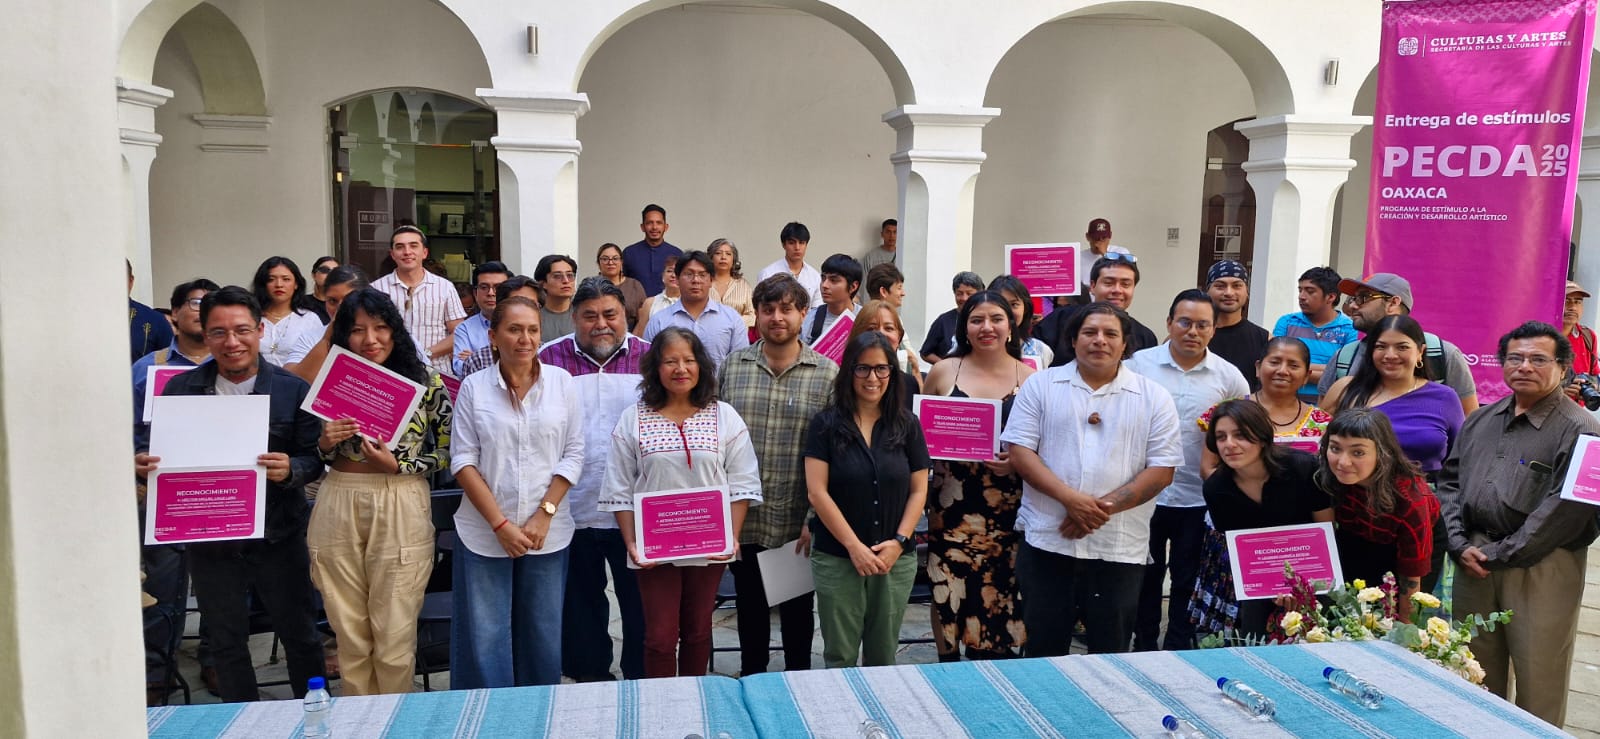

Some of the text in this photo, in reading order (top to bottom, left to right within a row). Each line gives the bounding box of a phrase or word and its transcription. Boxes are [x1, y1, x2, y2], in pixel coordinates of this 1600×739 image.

[1430, 31, 1567, 47] CULTURAS Y ARTES
[1384, 110, 1571, 129] Entrega de estímulos
[1382, 144, 1569, 178] PECDA 20
[1539, 160, 1568, 177] 25
[1381, 187, 1448, 199] OAXACA
[1432, 205, 1469, 213] ESTÍMULO
[1469, 213, 1508, 221] ARTÍSTICO
[345, 374, 395, 401] RECONOCIMIENTO
[176, 488, 238, 496] RECONOCIMIENTO
[1254, 545, 1311, 556] RECONOCIMIENTO
